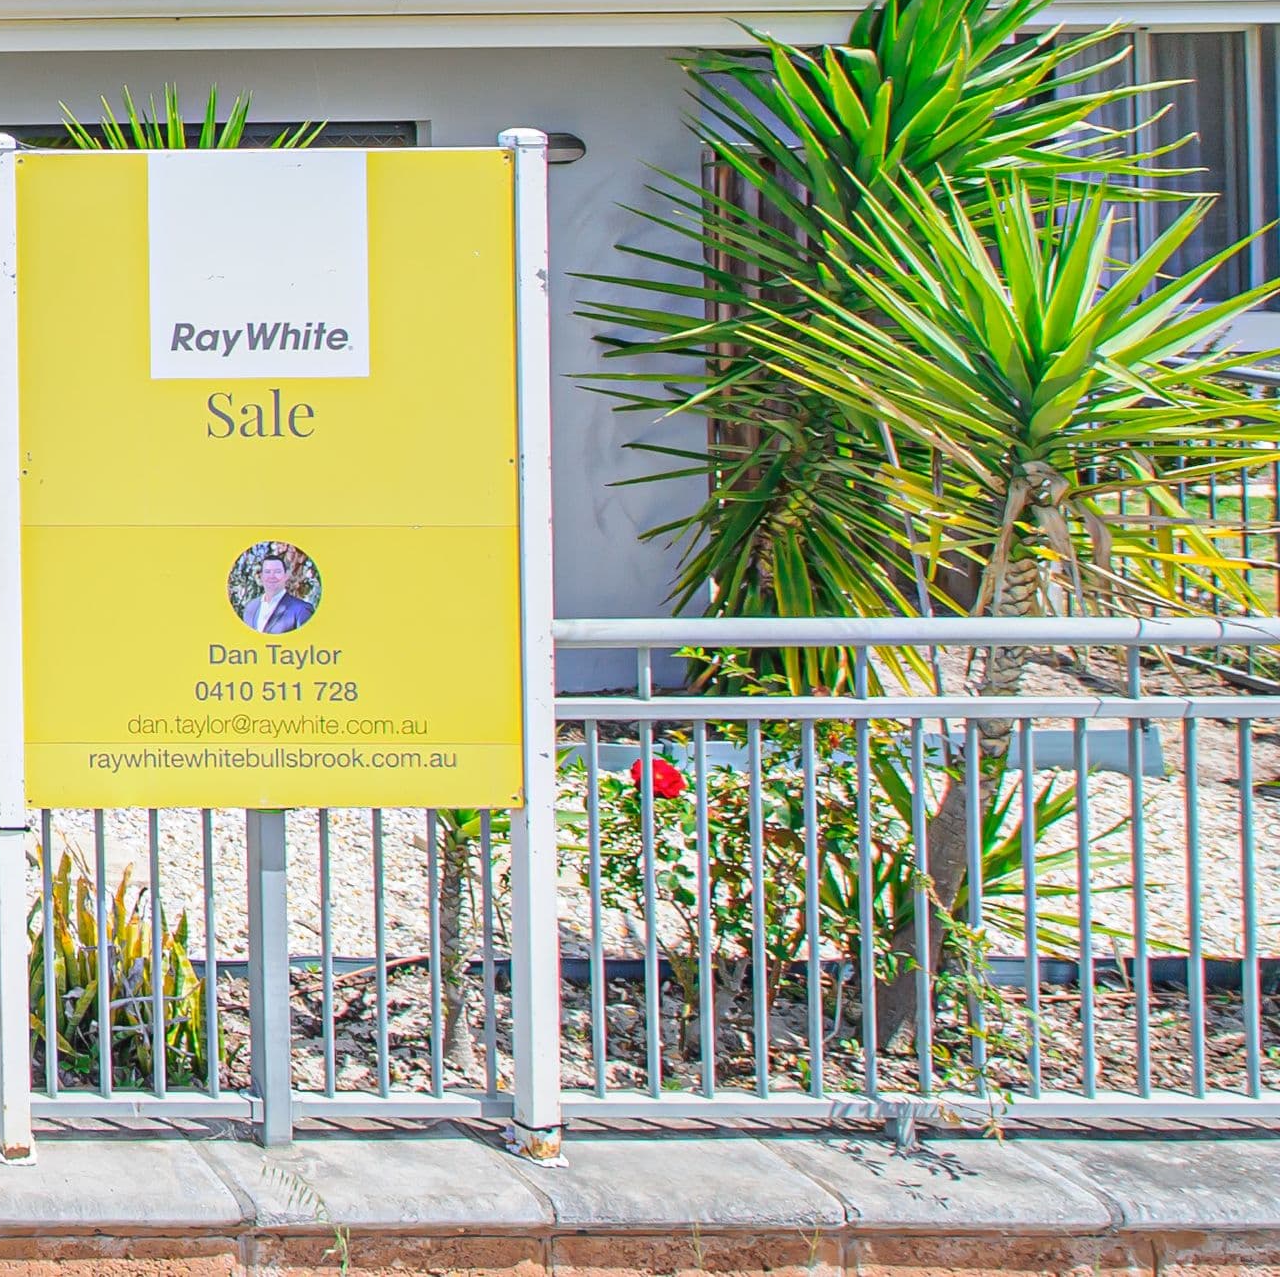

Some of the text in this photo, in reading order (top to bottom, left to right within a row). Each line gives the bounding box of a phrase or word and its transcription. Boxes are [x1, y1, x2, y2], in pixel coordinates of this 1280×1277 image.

[207, 388, 315, 439] Sale
[208, 643, 342, 670] Dan Taylor
[194, 680, 359, 702] 0410 511 728
[127, 713, 428, 739] dan.taylor@raywhite.com.au
[89, 747, 457, 774] raywhitewhitebullsbrook.com.au
